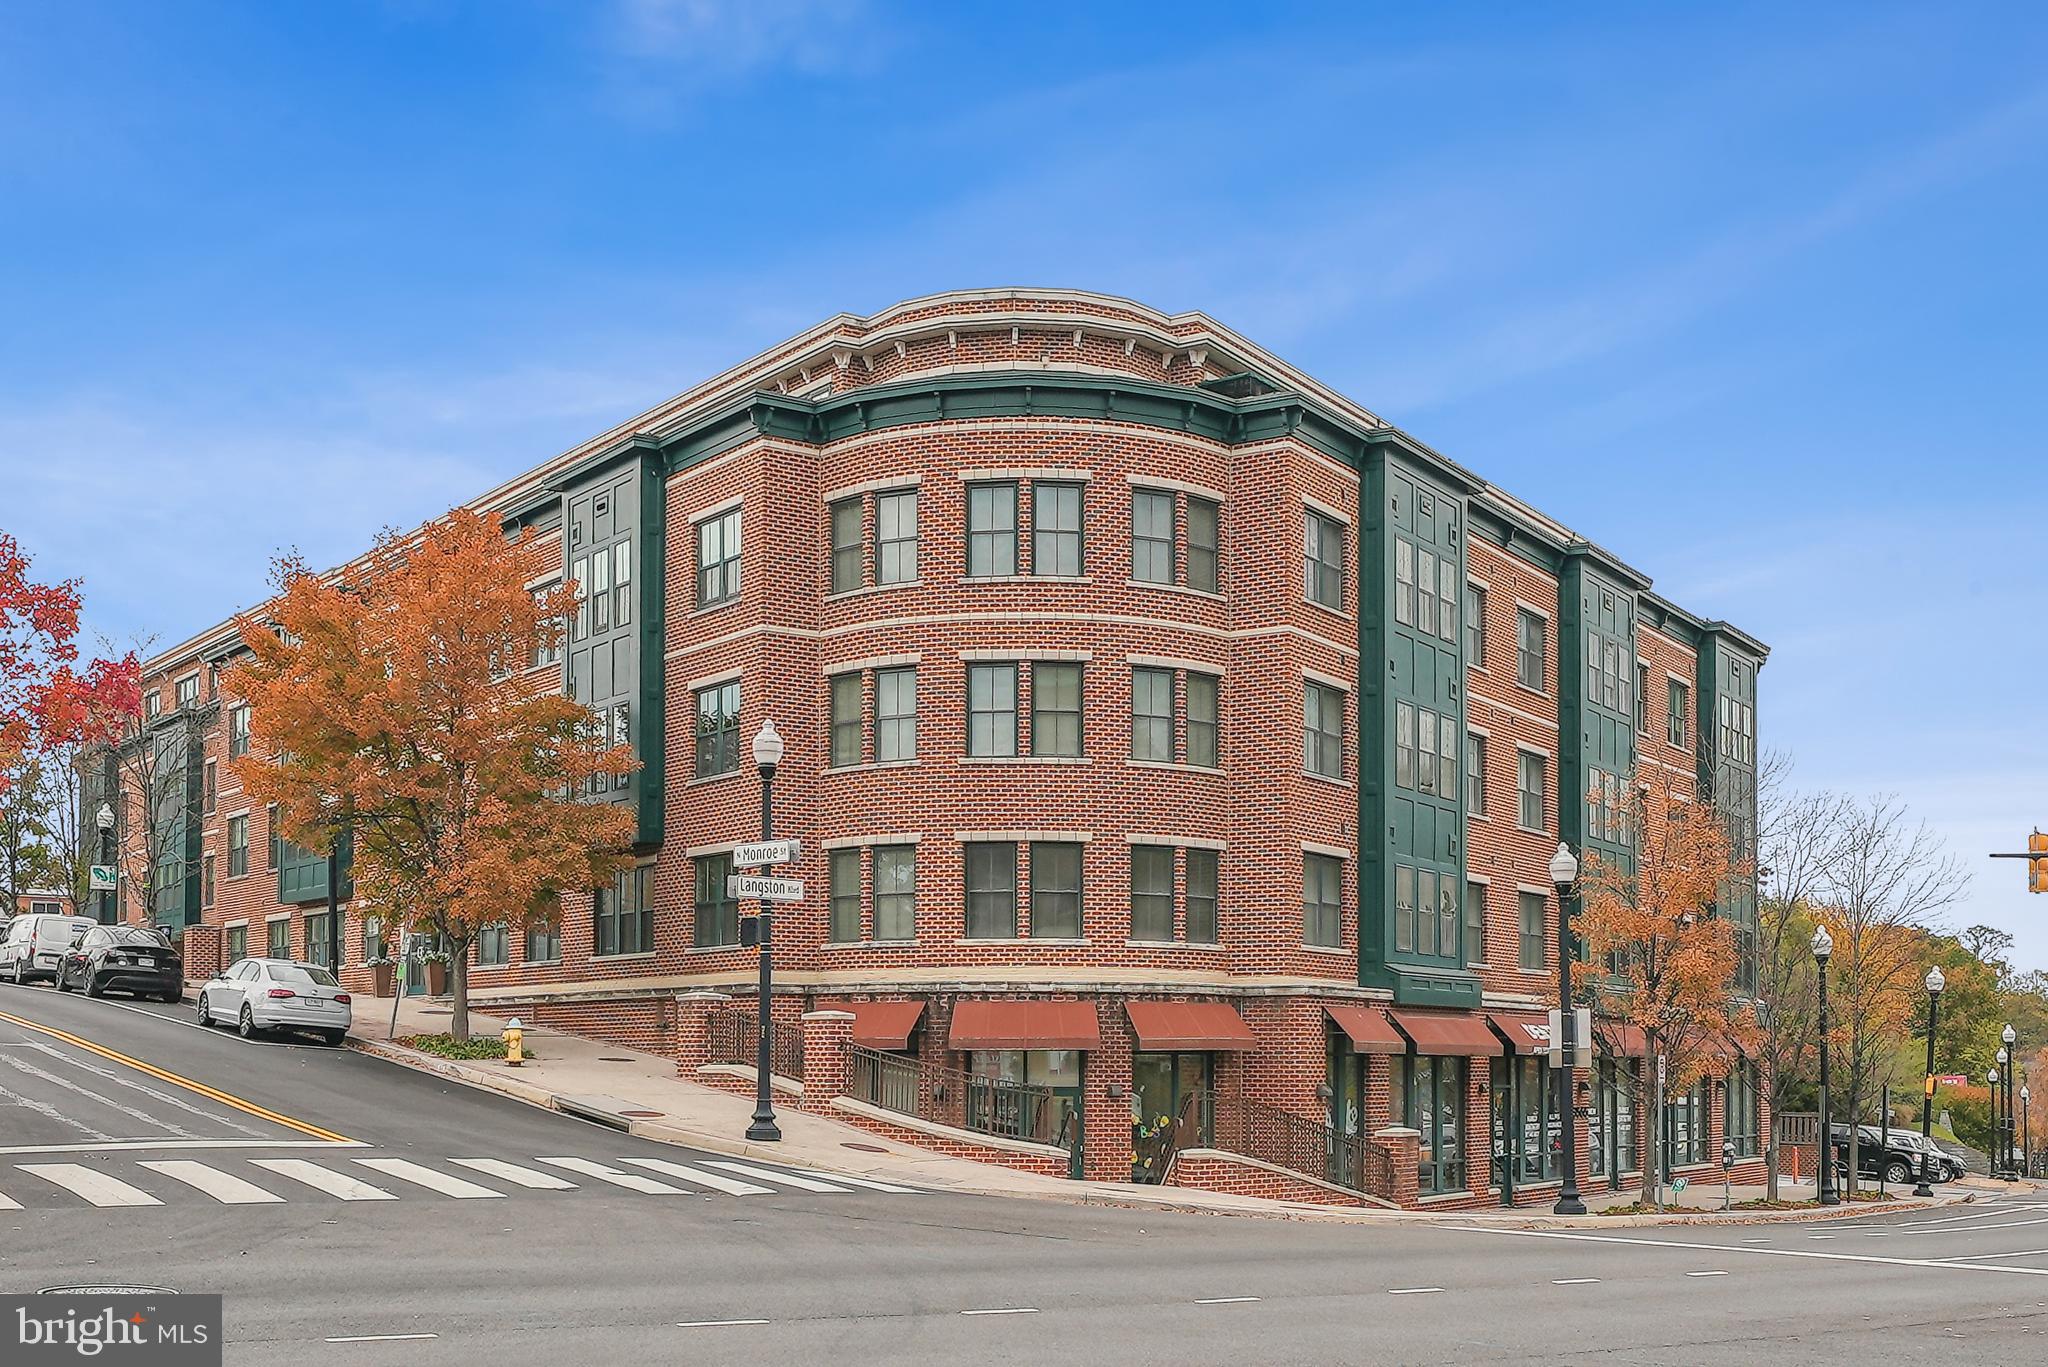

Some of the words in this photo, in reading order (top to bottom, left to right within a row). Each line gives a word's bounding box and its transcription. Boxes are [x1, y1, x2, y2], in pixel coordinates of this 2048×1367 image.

[743, 847, 779, 861] Monroe
[779, 847, 787, 856] St
[740, 878, 785, 896] Langston
